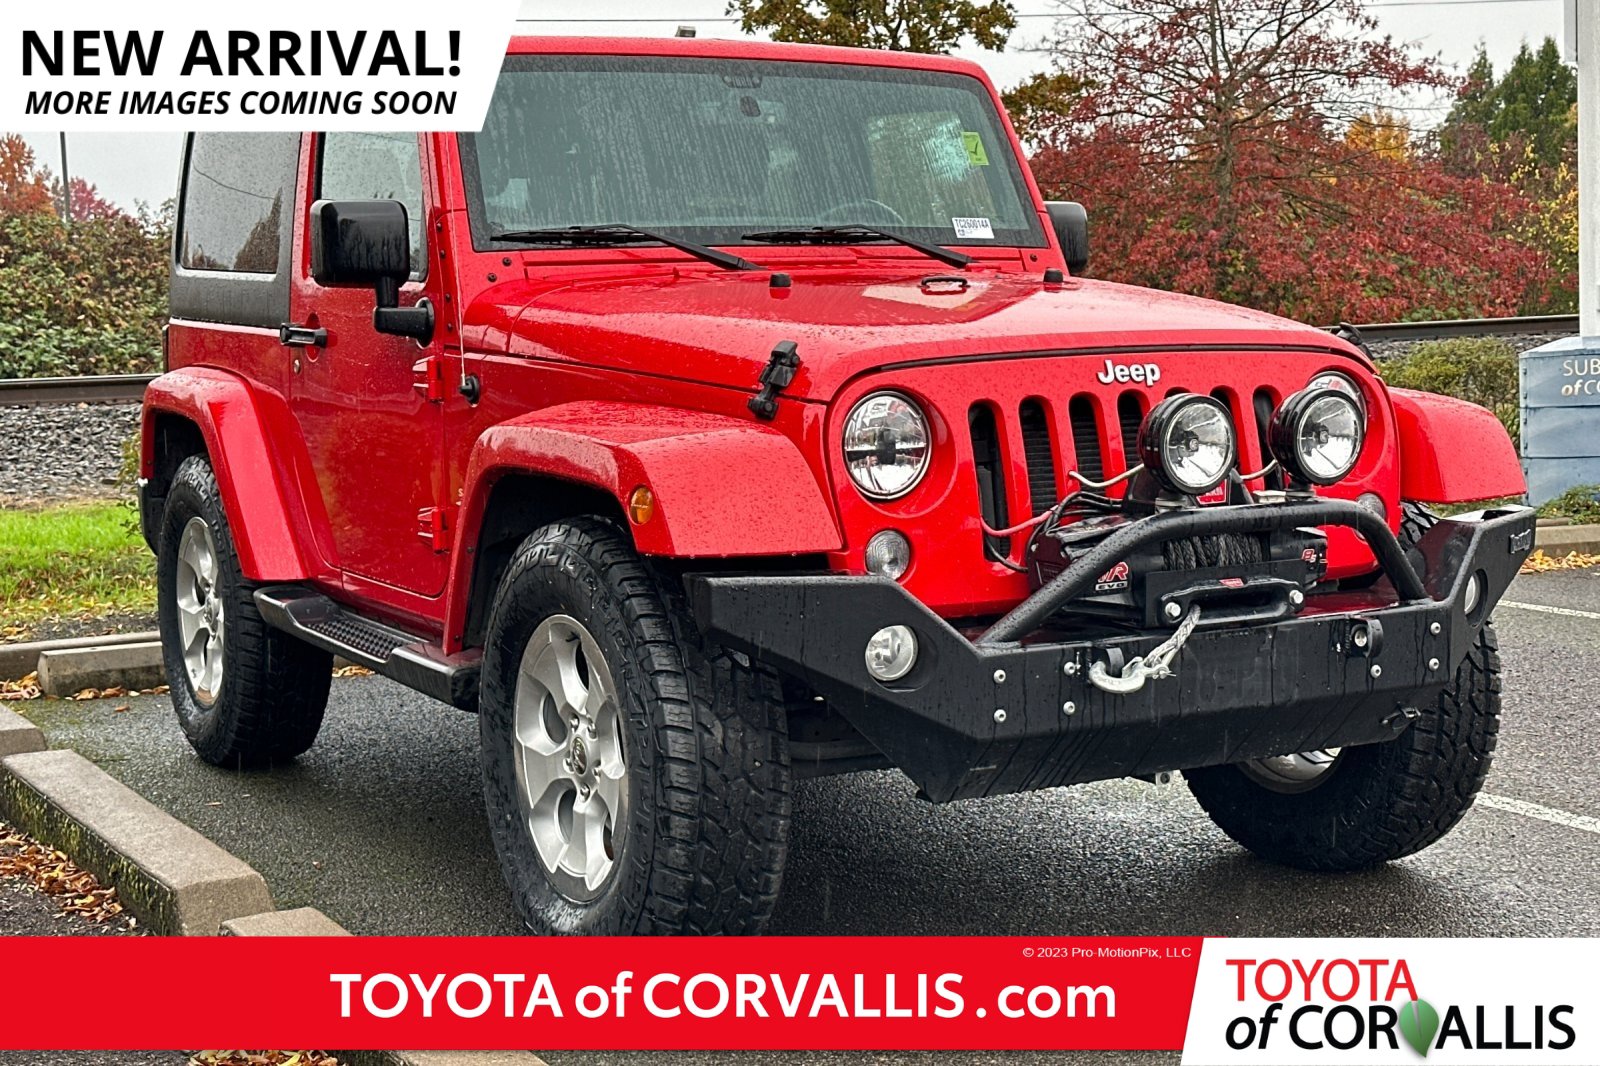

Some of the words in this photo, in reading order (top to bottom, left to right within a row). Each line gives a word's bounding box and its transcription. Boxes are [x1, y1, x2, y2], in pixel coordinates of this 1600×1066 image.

[1098, 360, 1161, 386] Jeep
[1584, 379, 1600, 395] C
[1096, 582, 1127, 590] EVO
